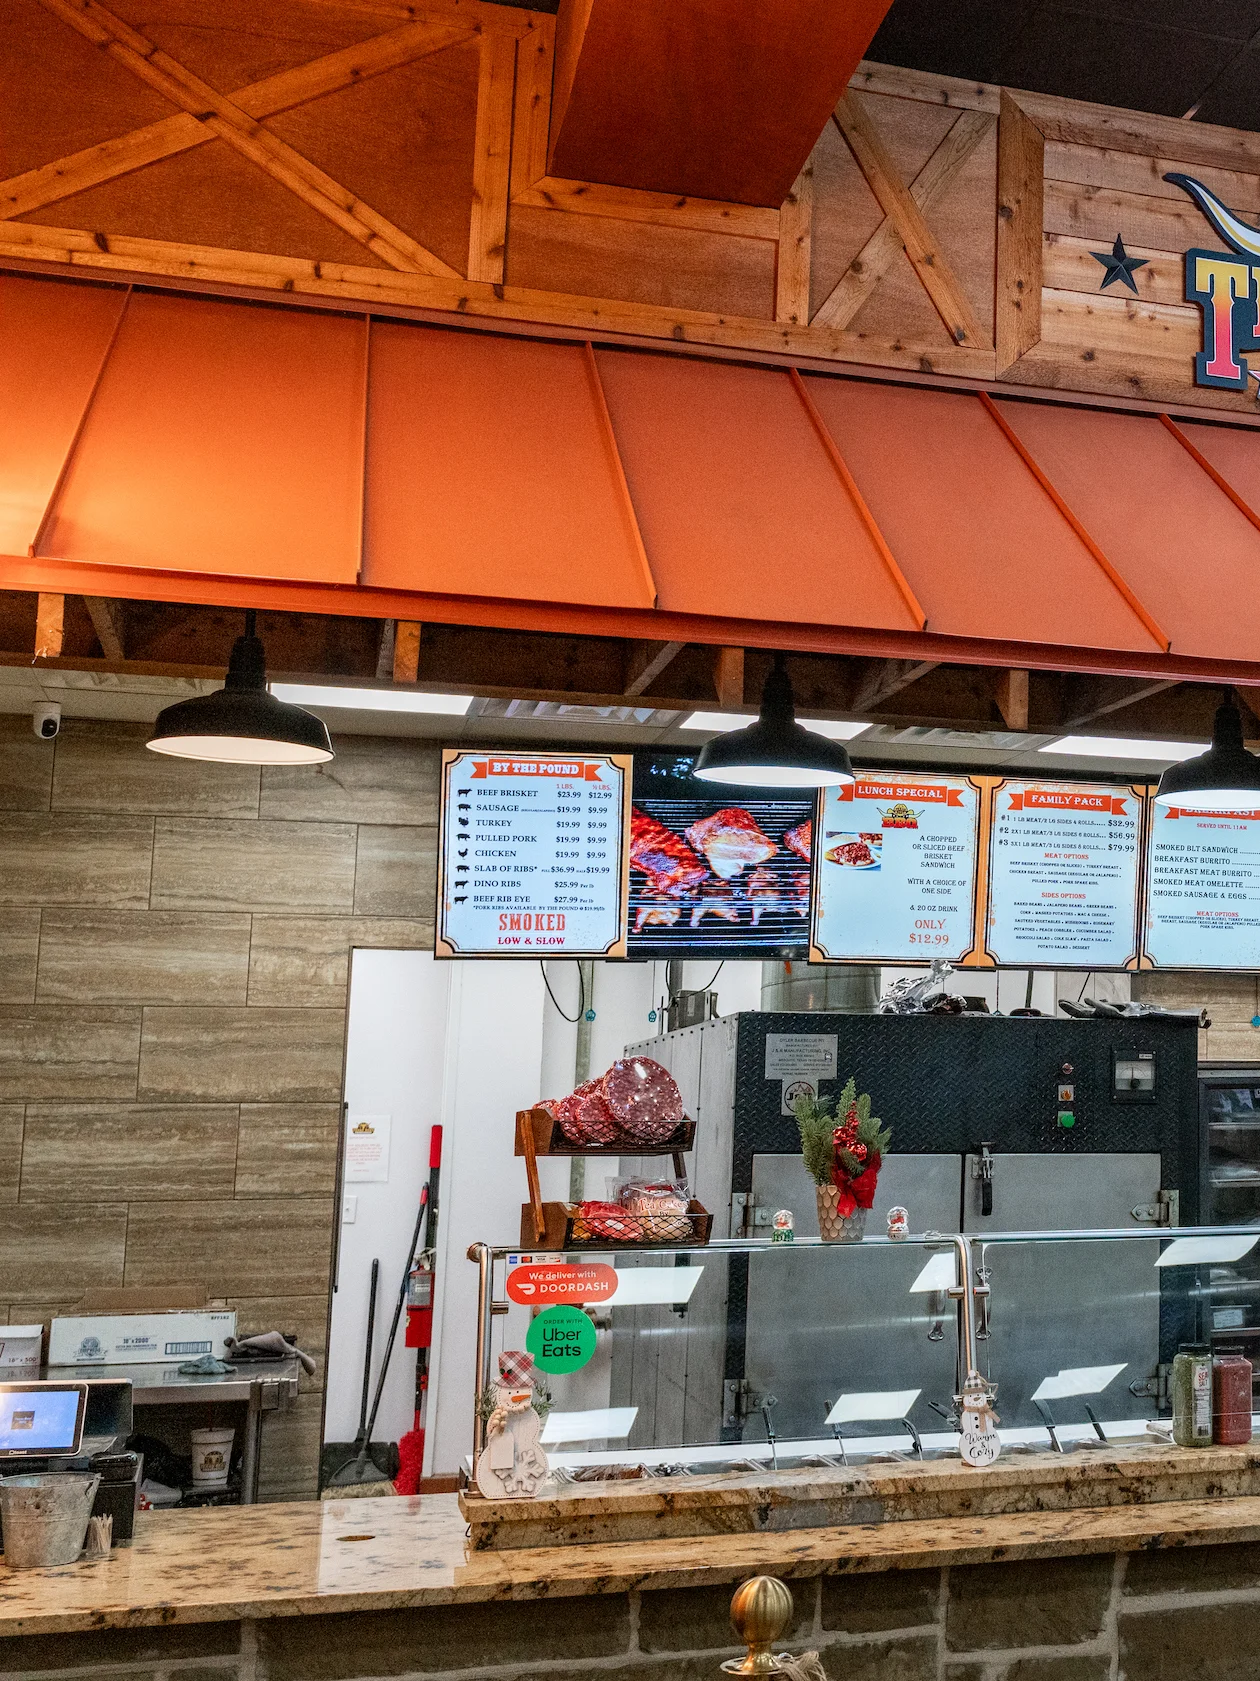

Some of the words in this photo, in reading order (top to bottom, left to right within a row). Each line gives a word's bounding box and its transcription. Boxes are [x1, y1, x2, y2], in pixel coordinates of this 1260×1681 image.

[493, 762, 510, 772] BY
[512, 763, 536, 772] THE
[540, 763, 579, 774] POUND
[858, 787, 893, 795] LUNCH
[896, 788, 942, 798] SPECIAL
[1032, 796, 1072, 804] FAMILY
[1074, 798, 1102, 806] PACK
[1202, 846, 1238, 854] SANDWICH
[1207, 880, 1243, 888] OMELETTE
[1184, 891, 1218, 899] SAUSAGE
[499, 913, 565, 931] SMOKED
[915, 919, 946, 929] ONLY
[909, 934, 949, 945] $12.99
[540, 1282, 609, 1292] DOORDASH
[543, 1328, 581, 1341] Uber
[543, 1344, 581, 1357] Eats
[965, 1433, 996, 1444] Warm
